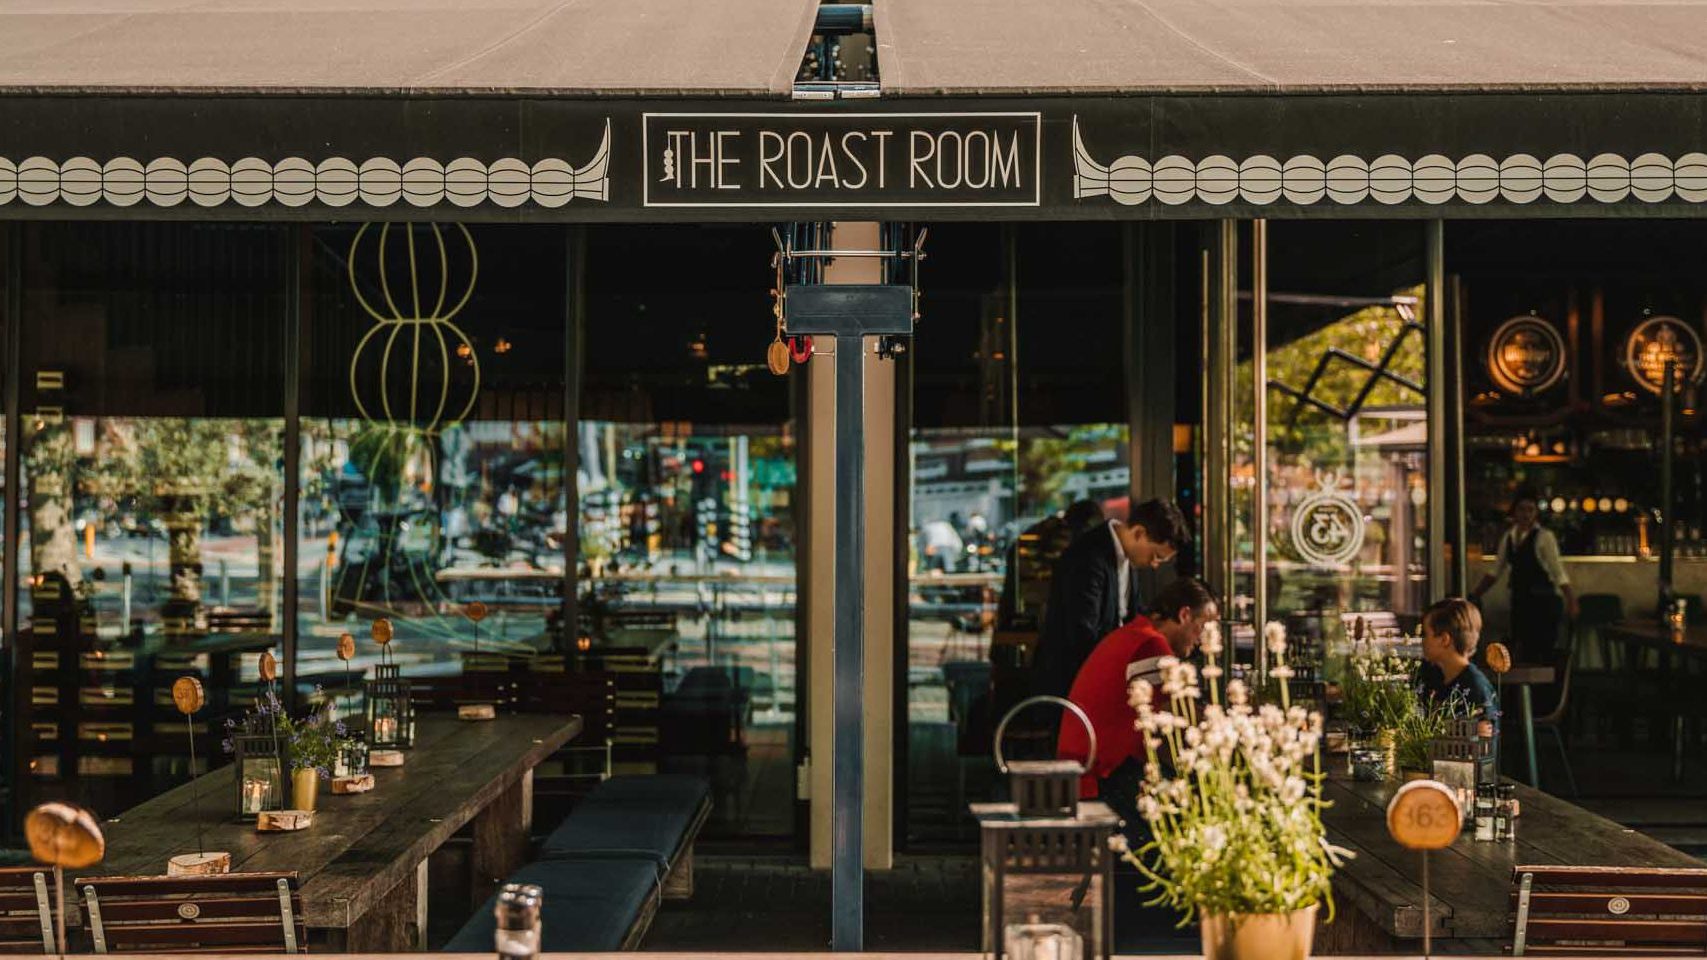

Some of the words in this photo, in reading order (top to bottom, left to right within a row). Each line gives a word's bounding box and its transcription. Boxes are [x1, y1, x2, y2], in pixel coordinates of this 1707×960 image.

[666, 131, 741, 189] THE
[759, 130, 894, 189] ROAST
[910, 129, 1021, 188] ROOM
